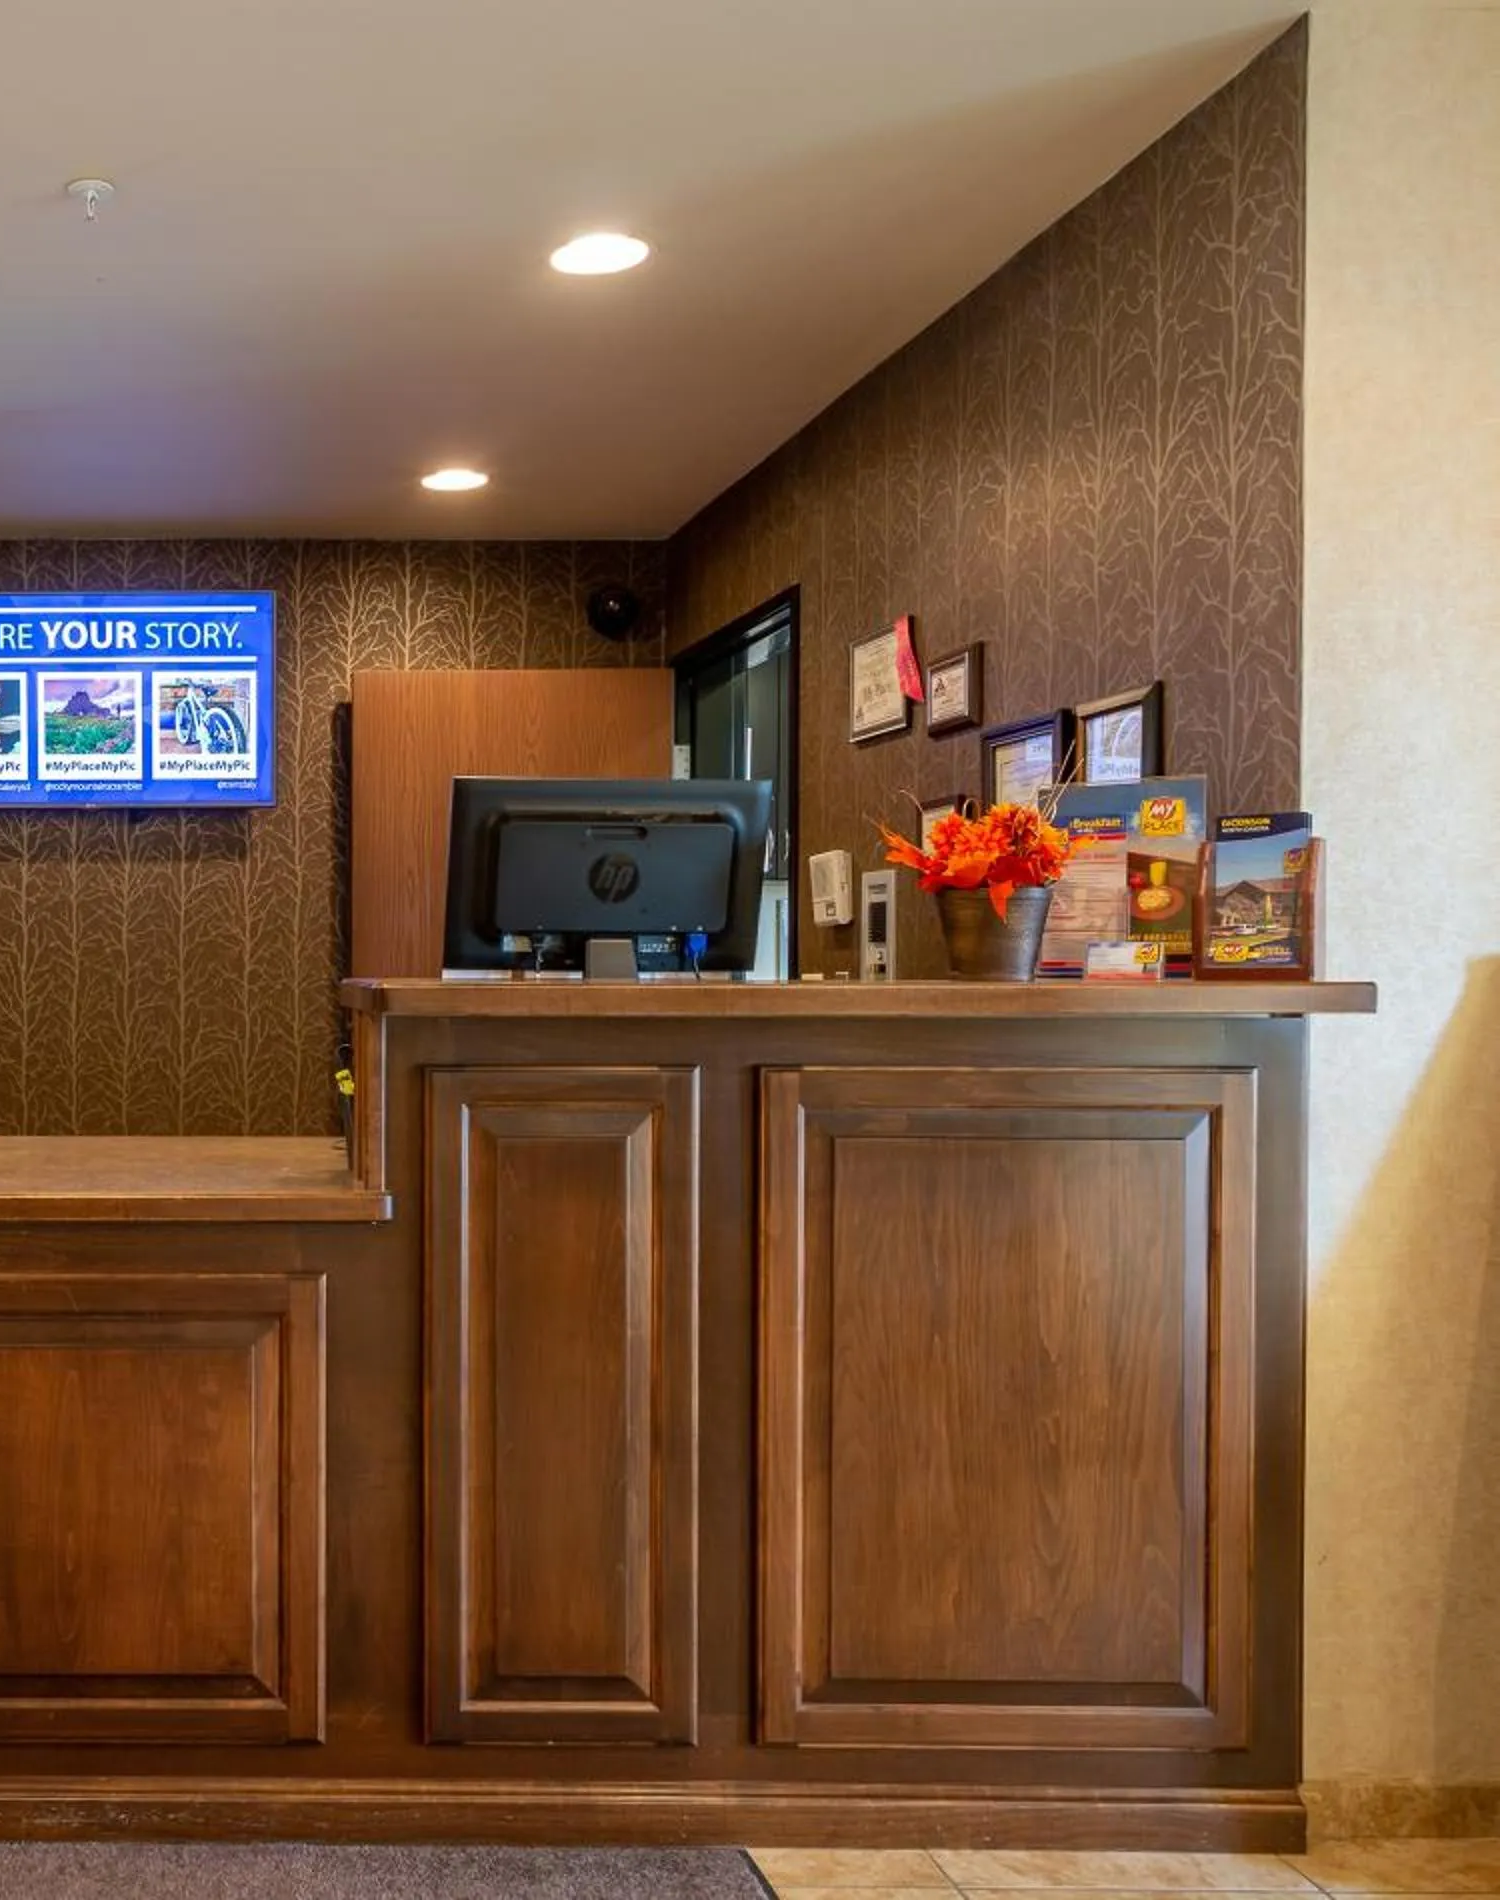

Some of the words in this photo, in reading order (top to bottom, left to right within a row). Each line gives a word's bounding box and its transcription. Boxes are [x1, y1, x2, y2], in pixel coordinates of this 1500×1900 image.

[40, 621, 137, 649] YOUR
[145, 622, 244, 649] STORY.
[45, 760, 136, 773] #MyPlaceMyPic
[159, 760, 251, 773] #MyPlaceMyPic
